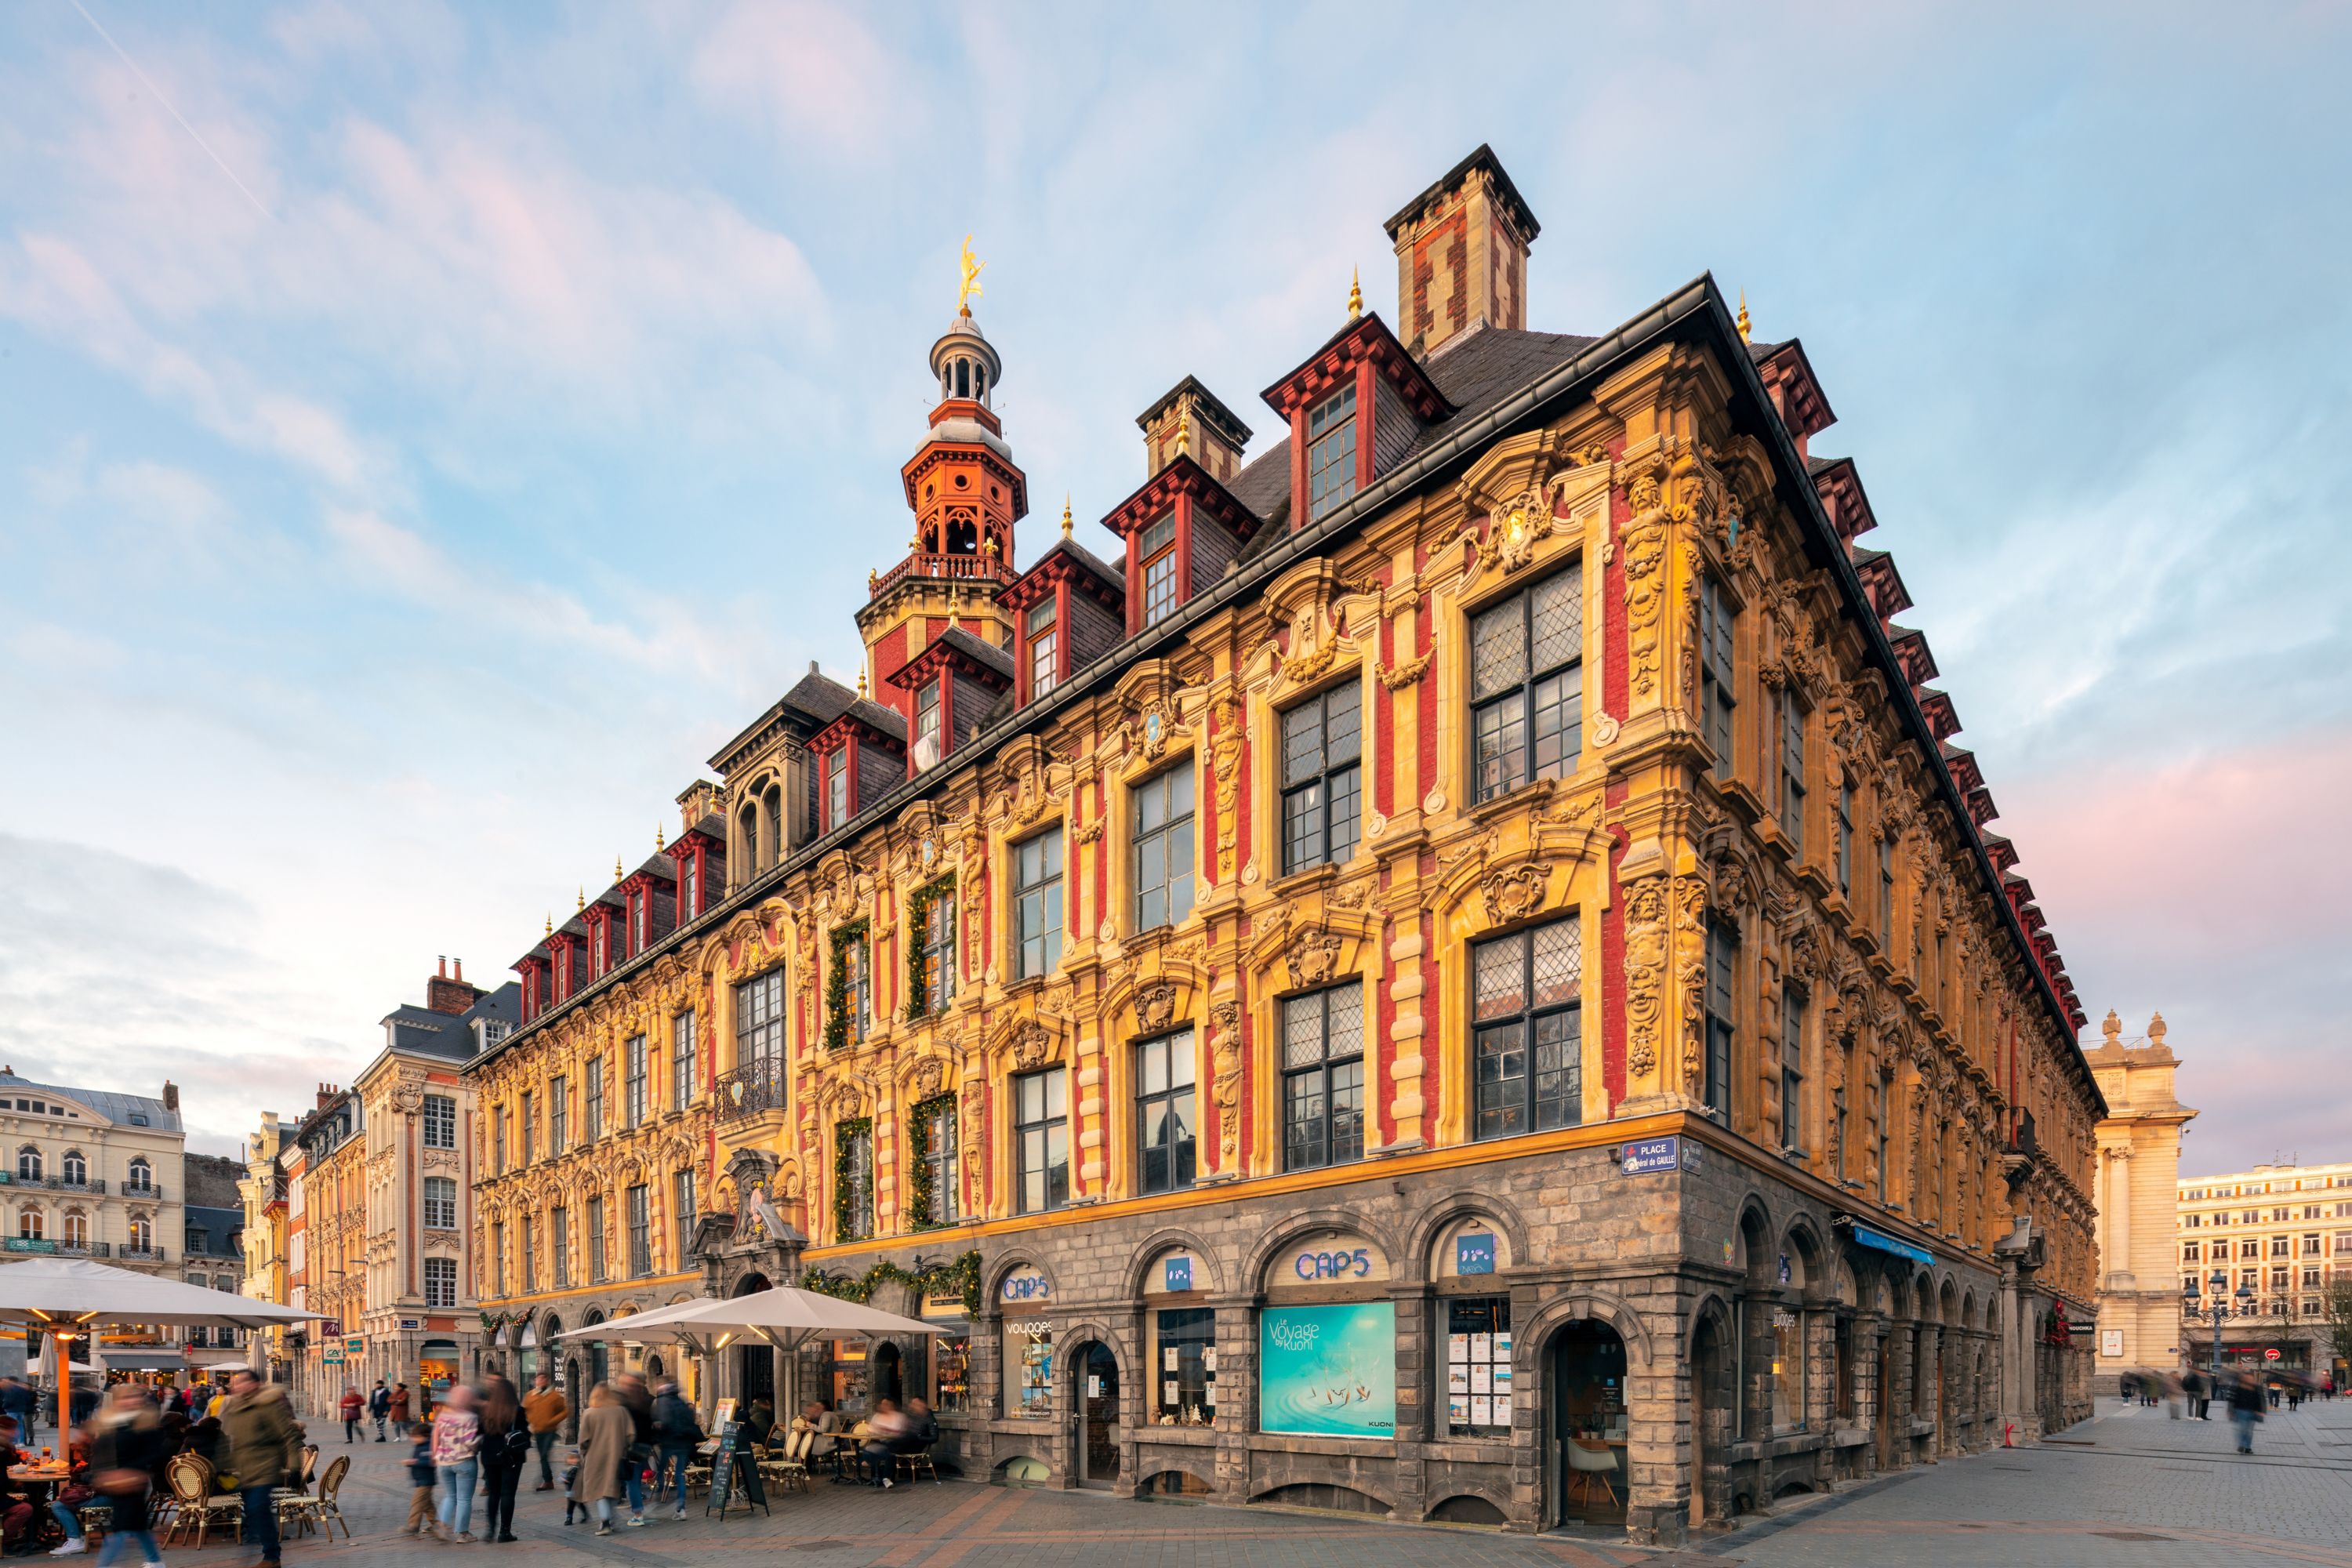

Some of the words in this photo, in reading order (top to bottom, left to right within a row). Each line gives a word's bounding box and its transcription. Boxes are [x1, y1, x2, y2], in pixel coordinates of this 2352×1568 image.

[1641, 1144, 1667, 1155] PLACE
[1657, 1155, 1675, 1165] GAULLE
[943, 1285, 963, 1298] PLAC
[1006, 1321, 1052, 1338] voyages
[1269, 1322, 1319, 1342] Voyage
[1275, 1338, 1283, 1348] by
